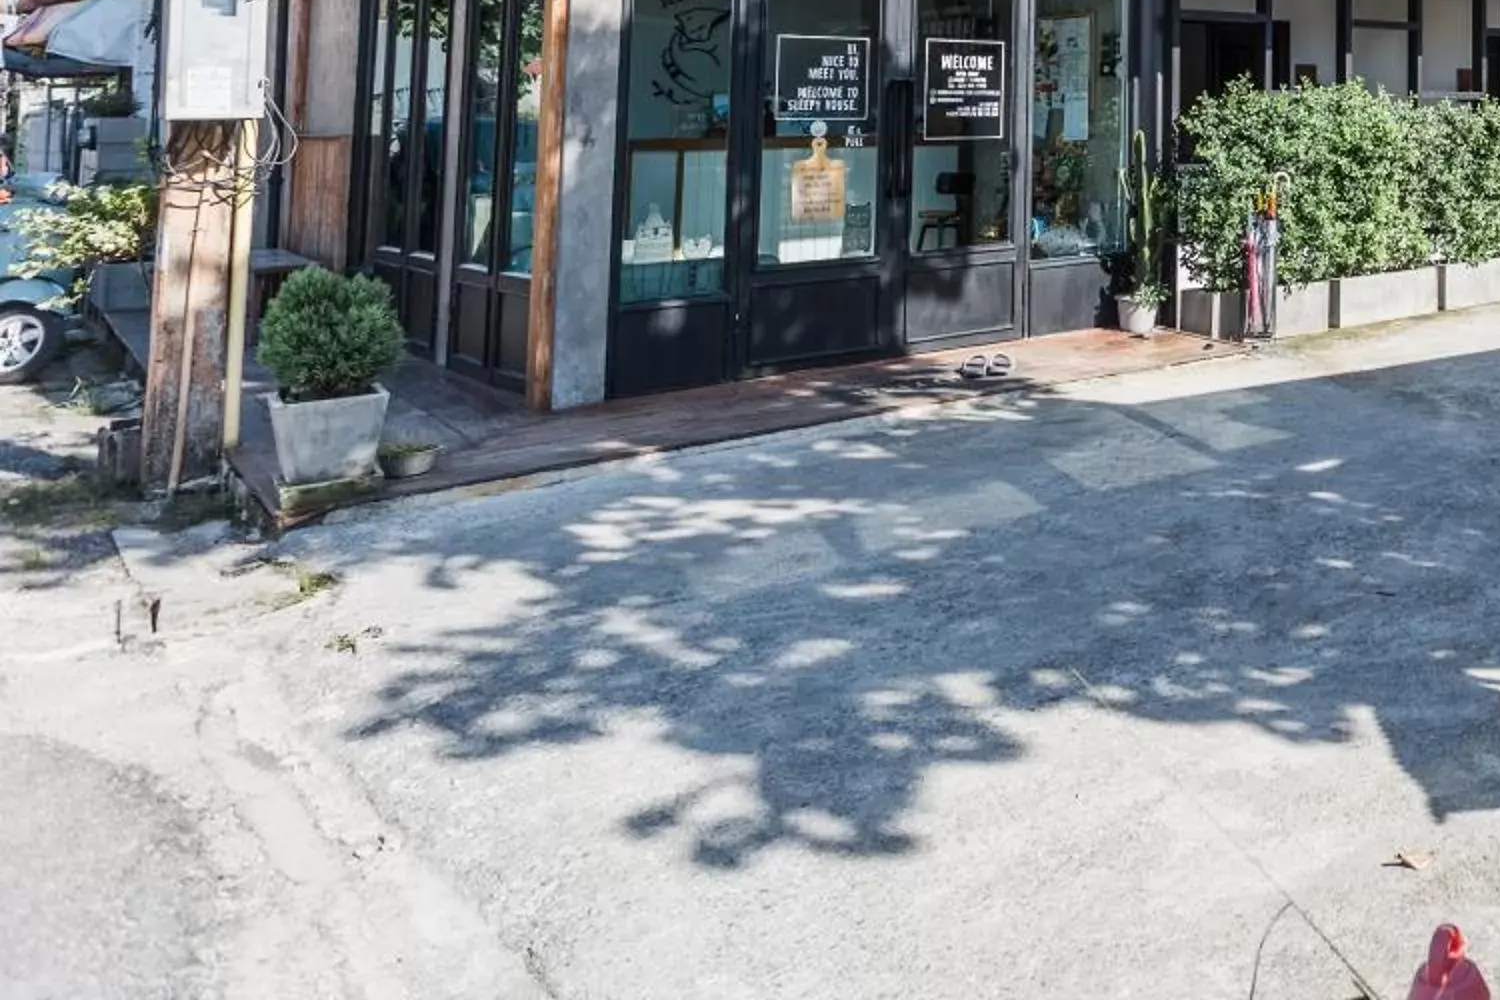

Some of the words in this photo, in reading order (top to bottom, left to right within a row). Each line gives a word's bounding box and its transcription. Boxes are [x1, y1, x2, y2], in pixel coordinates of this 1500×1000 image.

[821, 55, 845, 67] NICE
[940, 53, 994, 71] WELCOME
[807, 67, 836, 80] MEET
[797, 86, 843, 99] WELCOME
[847, 87, 859, 98] TO
[787, 99, 821, 112] SLEEPY
